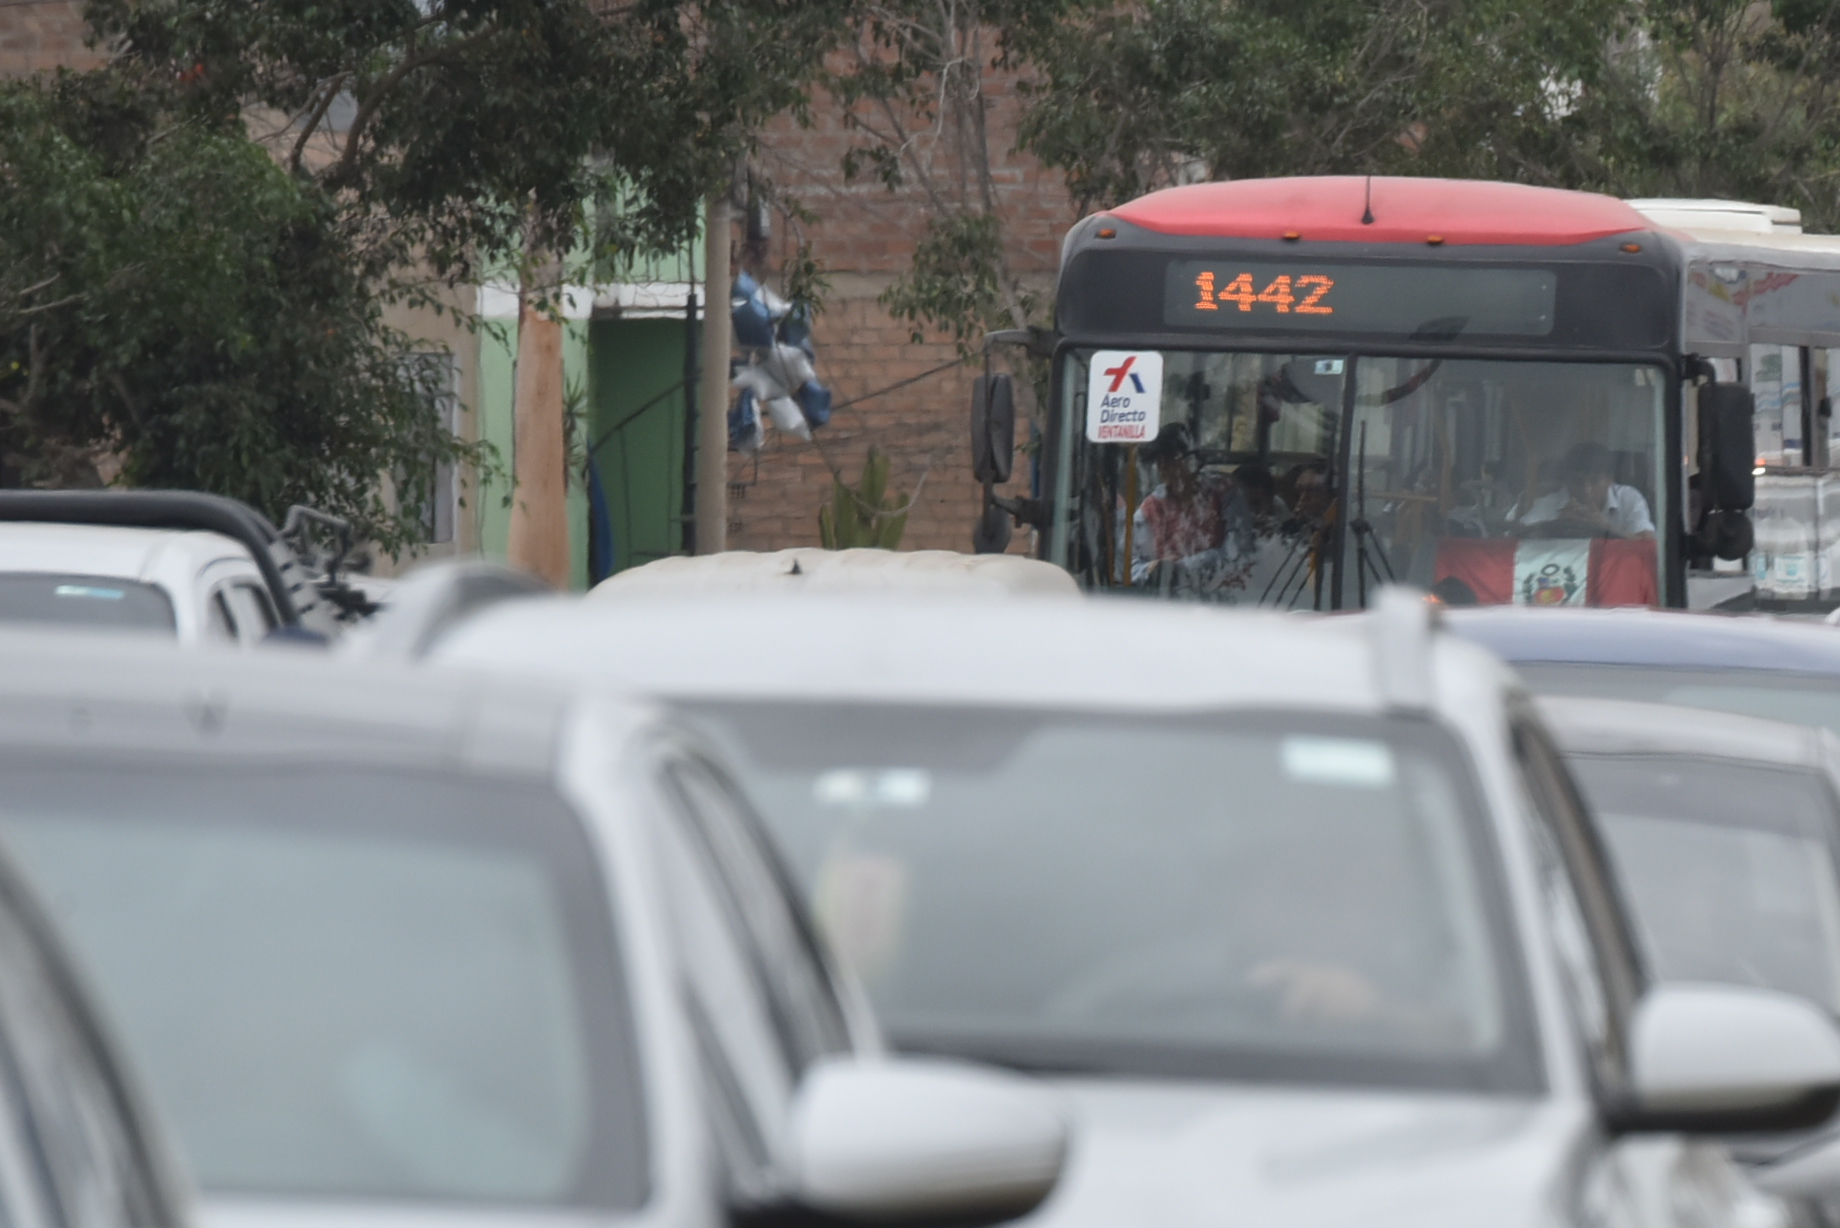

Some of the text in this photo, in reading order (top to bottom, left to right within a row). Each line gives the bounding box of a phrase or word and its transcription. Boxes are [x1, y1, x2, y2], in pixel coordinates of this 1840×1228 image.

[1195, 271, 1334, 314] 1442
[1100, 393, 1131, 408] Aero
[1100, 409, 1146, 424] Directo
